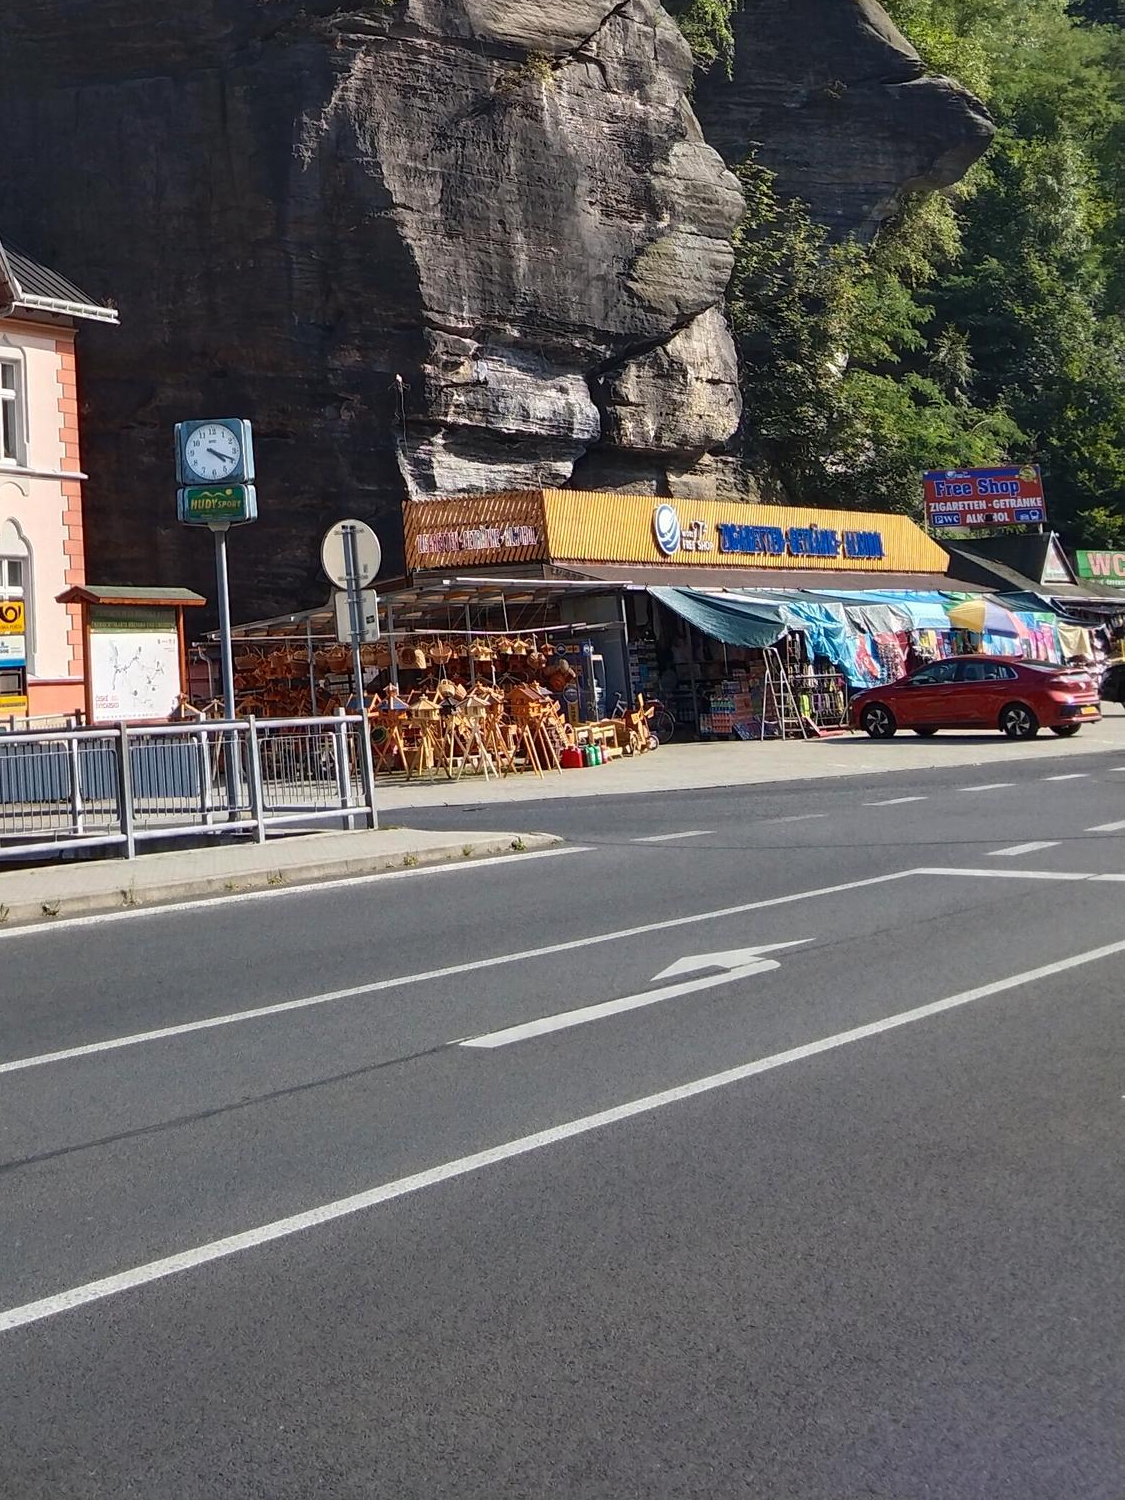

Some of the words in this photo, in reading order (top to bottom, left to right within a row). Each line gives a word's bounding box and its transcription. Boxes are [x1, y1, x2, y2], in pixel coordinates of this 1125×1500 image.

[934, 480, 973, 498] Free
[977, 478, 1020, 497] Shop
[191, 498, 217, 510] HUDY
[218, 500, 241, 508] SPORT
[929, 500, 987, 513] ZIGARETTEN
[993, 496, 1043, 510] GETRÄNKE
